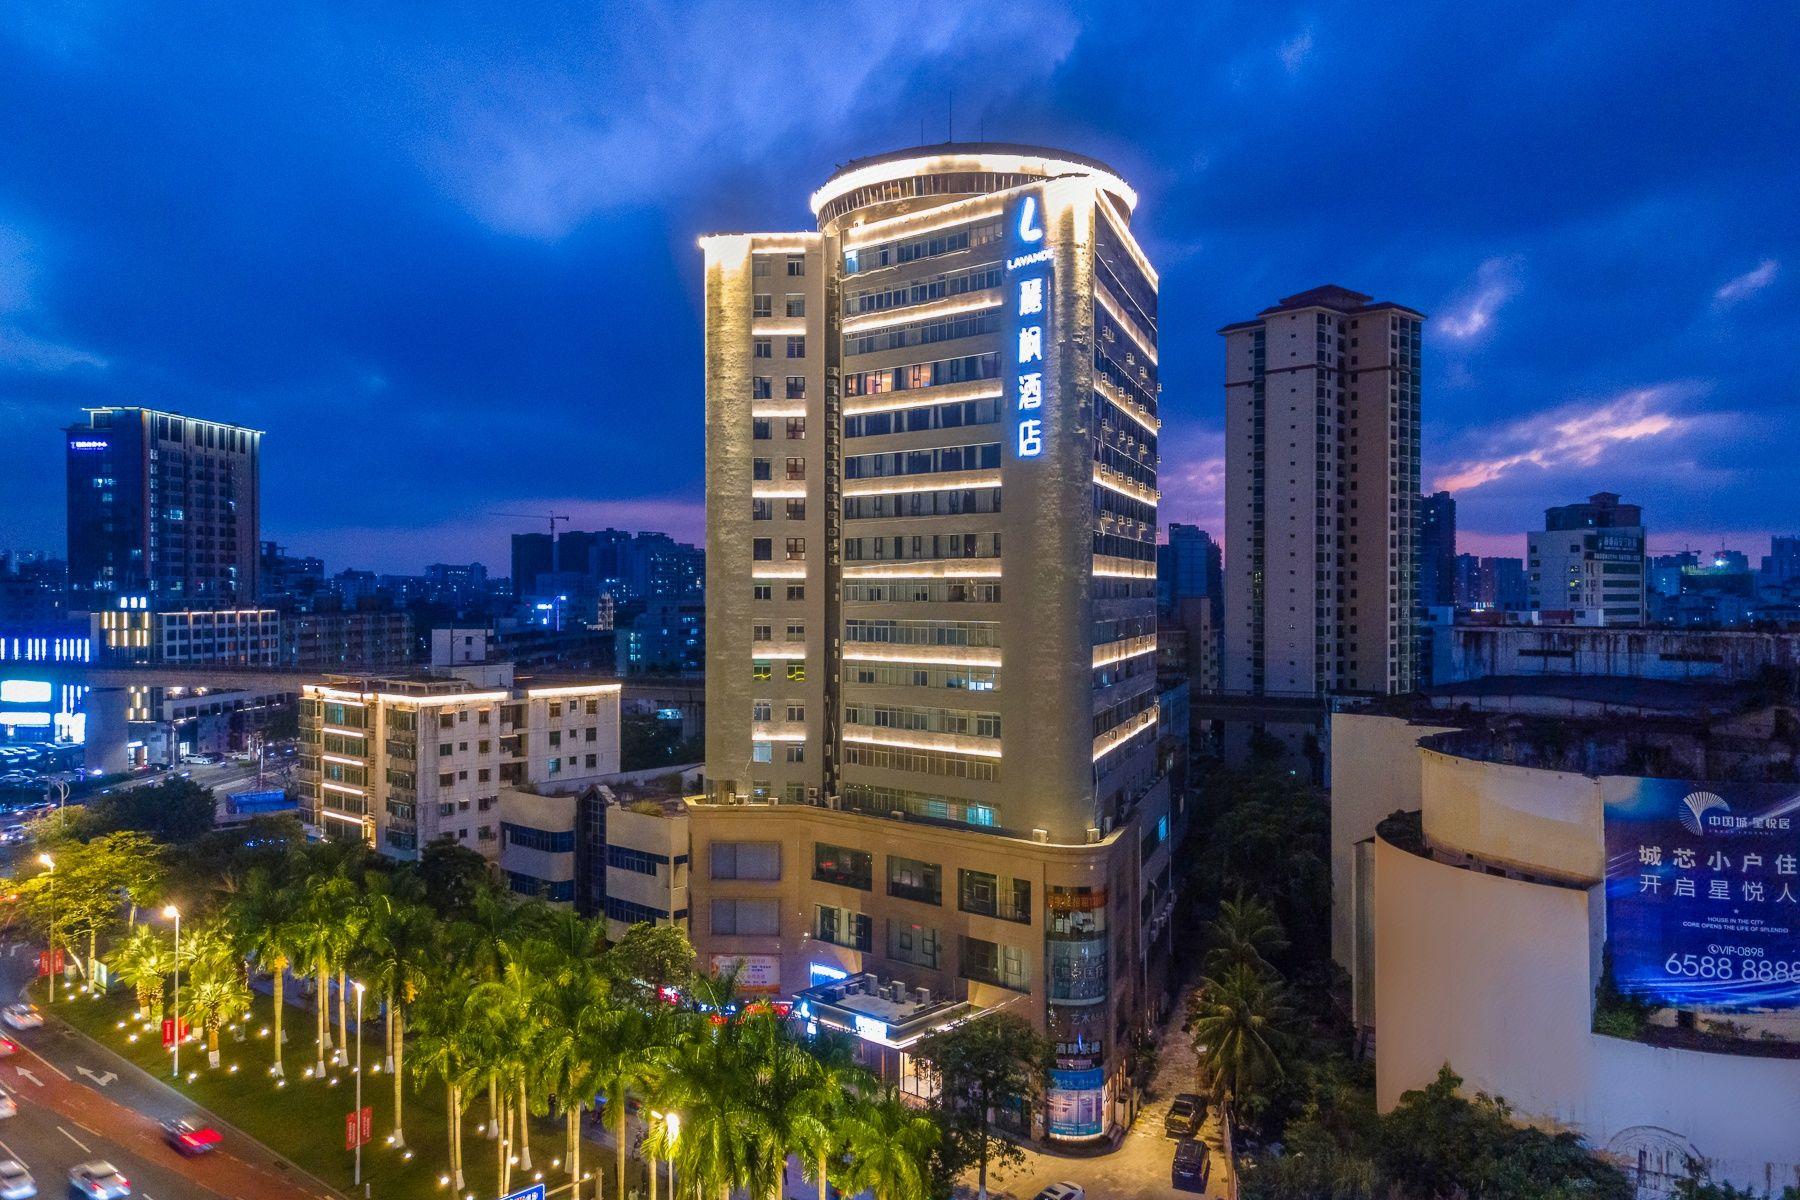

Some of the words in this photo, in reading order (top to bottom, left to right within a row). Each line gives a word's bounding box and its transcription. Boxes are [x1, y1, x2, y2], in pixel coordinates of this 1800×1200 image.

[1638, 844, 1798, 875] 城芯小户住
[1640, 873, 1797, 903] 开启星悦人
[1701, 922, 1722, 930] OPENS
[1718, 945, 1764, 957] VIP-0898
[1665, 953, 1733, 980] 6588
[1741, 959, 1800, 983] 8888
